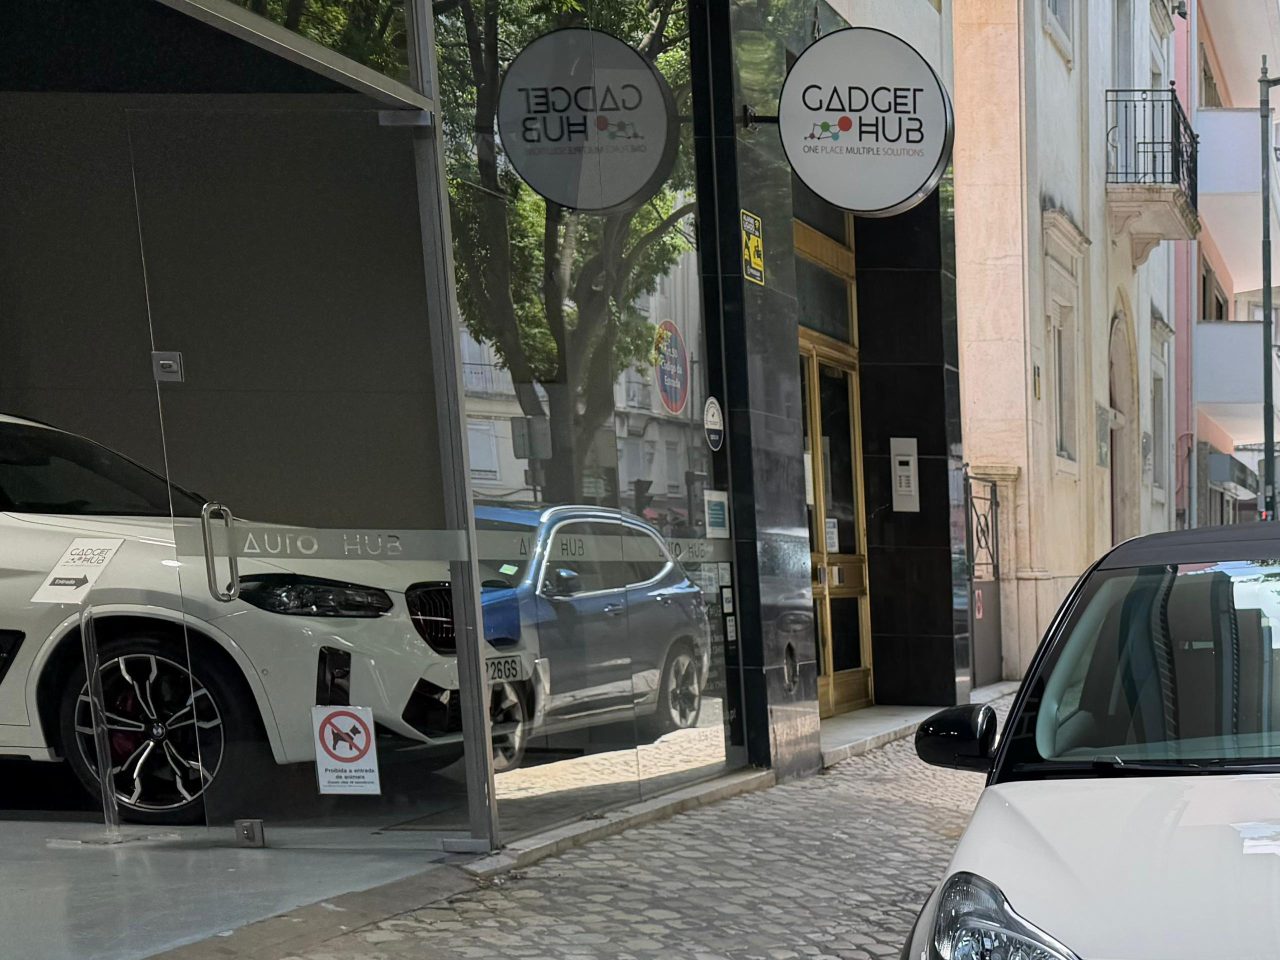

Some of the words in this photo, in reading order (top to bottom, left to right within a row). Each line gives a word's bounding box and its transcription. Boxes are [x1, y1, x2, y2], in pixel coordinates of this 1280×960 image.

[801, 84, 925, 115] GADGET
[858, 115, 925, 144] HUB
[802, 145, 819, 154] ONE
[820, 146, 844, 155] PLACE
[845, 146, 881, 156] MULTIPLE
[882, 147, 925, 157] SOLUTIONS
[70, 547, 113, 557] GADGET
[243, 532, 319, 554] AUTO
[343, 533, 402, 555] HUB
[82, 556, 106, 564] HUB
